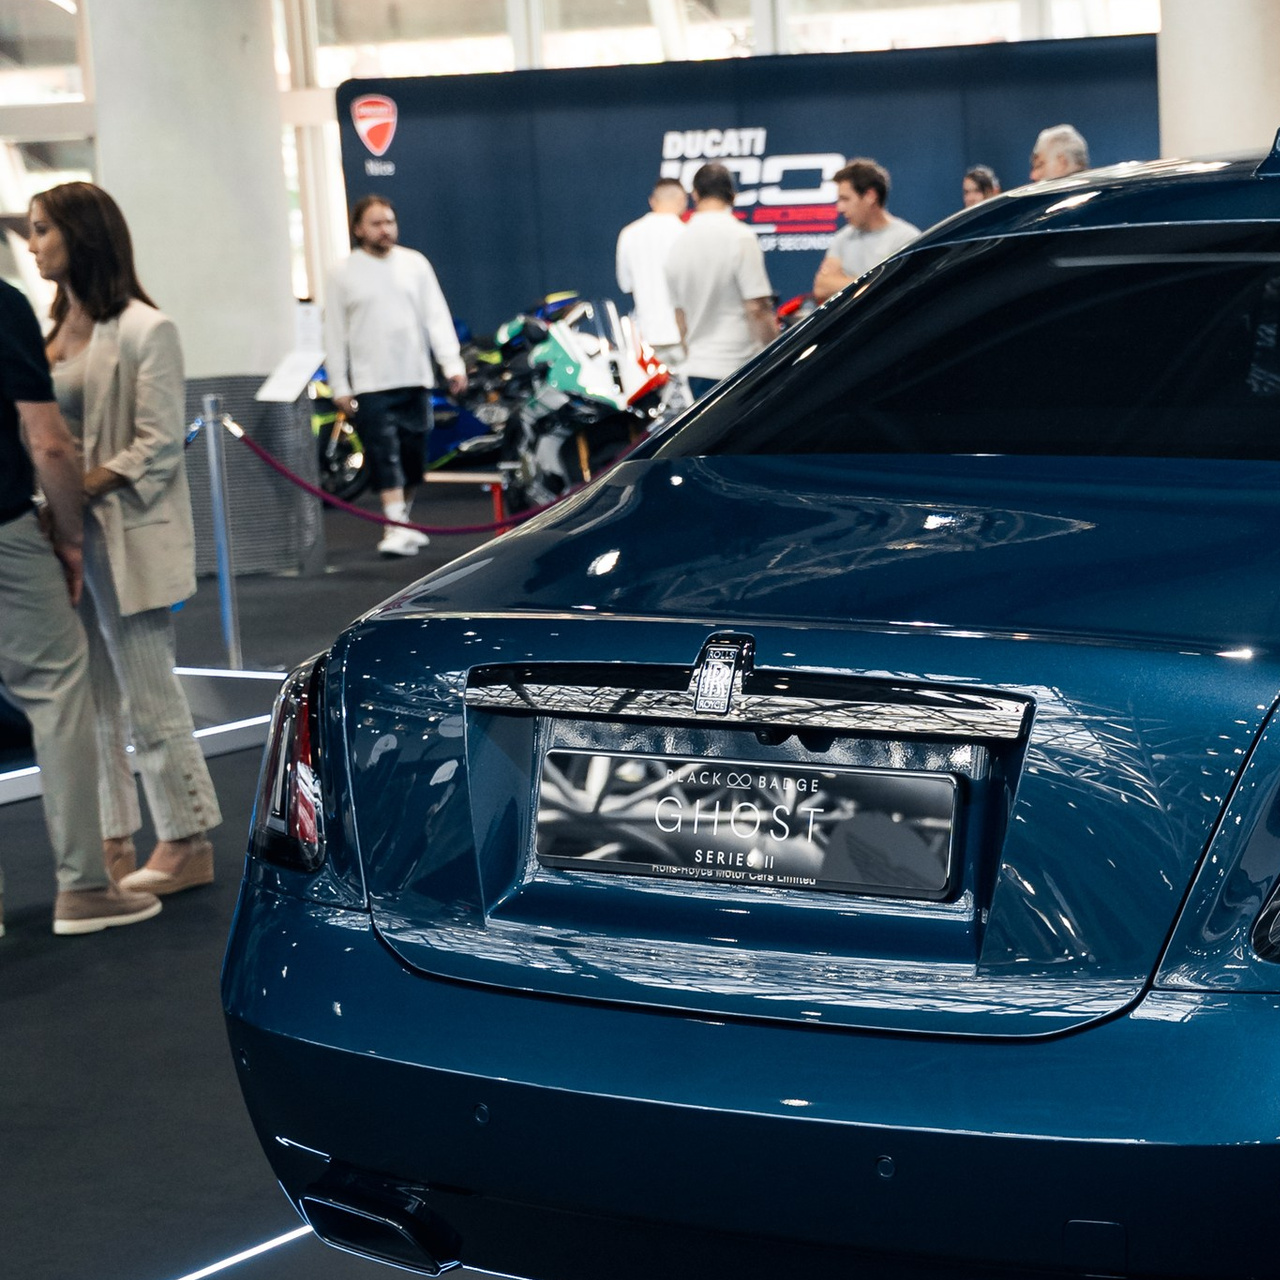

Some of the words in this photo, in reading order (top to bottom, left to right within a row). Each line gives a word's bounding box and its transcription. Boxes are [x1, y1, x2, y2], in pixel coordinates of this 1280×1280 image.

[662, 126, 768, 160] DUCATI
[699, 701, 725, 710] ROYCE
[666, 770, 721, 786] BLACK
[758, 777, 819, 792] BADGE
[655, 796, 825, 843] GHOST
